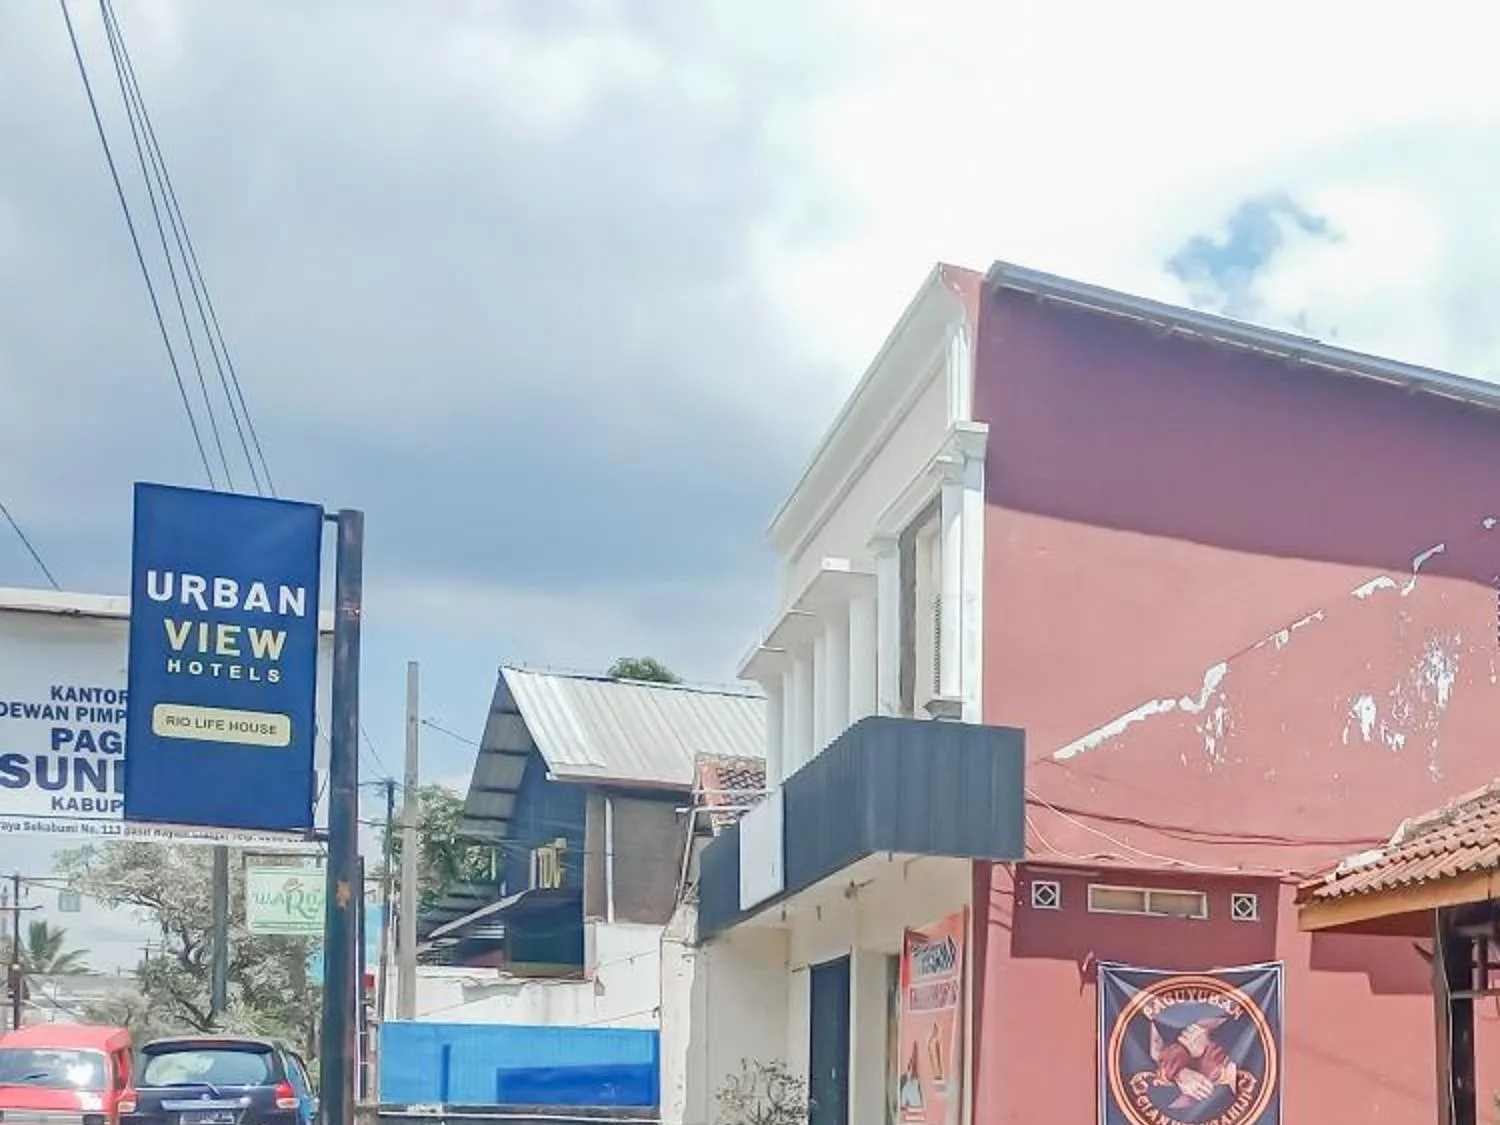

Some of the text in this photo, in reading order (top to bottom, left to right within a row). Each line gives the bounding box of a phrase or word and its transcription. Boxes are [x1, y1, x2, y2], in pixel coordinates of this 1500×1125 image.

[147, 570, 305, 617] URBAN
[164, 618, 287, 661] VIEW
[167, 658, 281, 683] HOTELS
[165, 715, 278, 735] RIO LIFE HOUSE
[1143, 988, 1244, 1021] PAGUYUBAN
